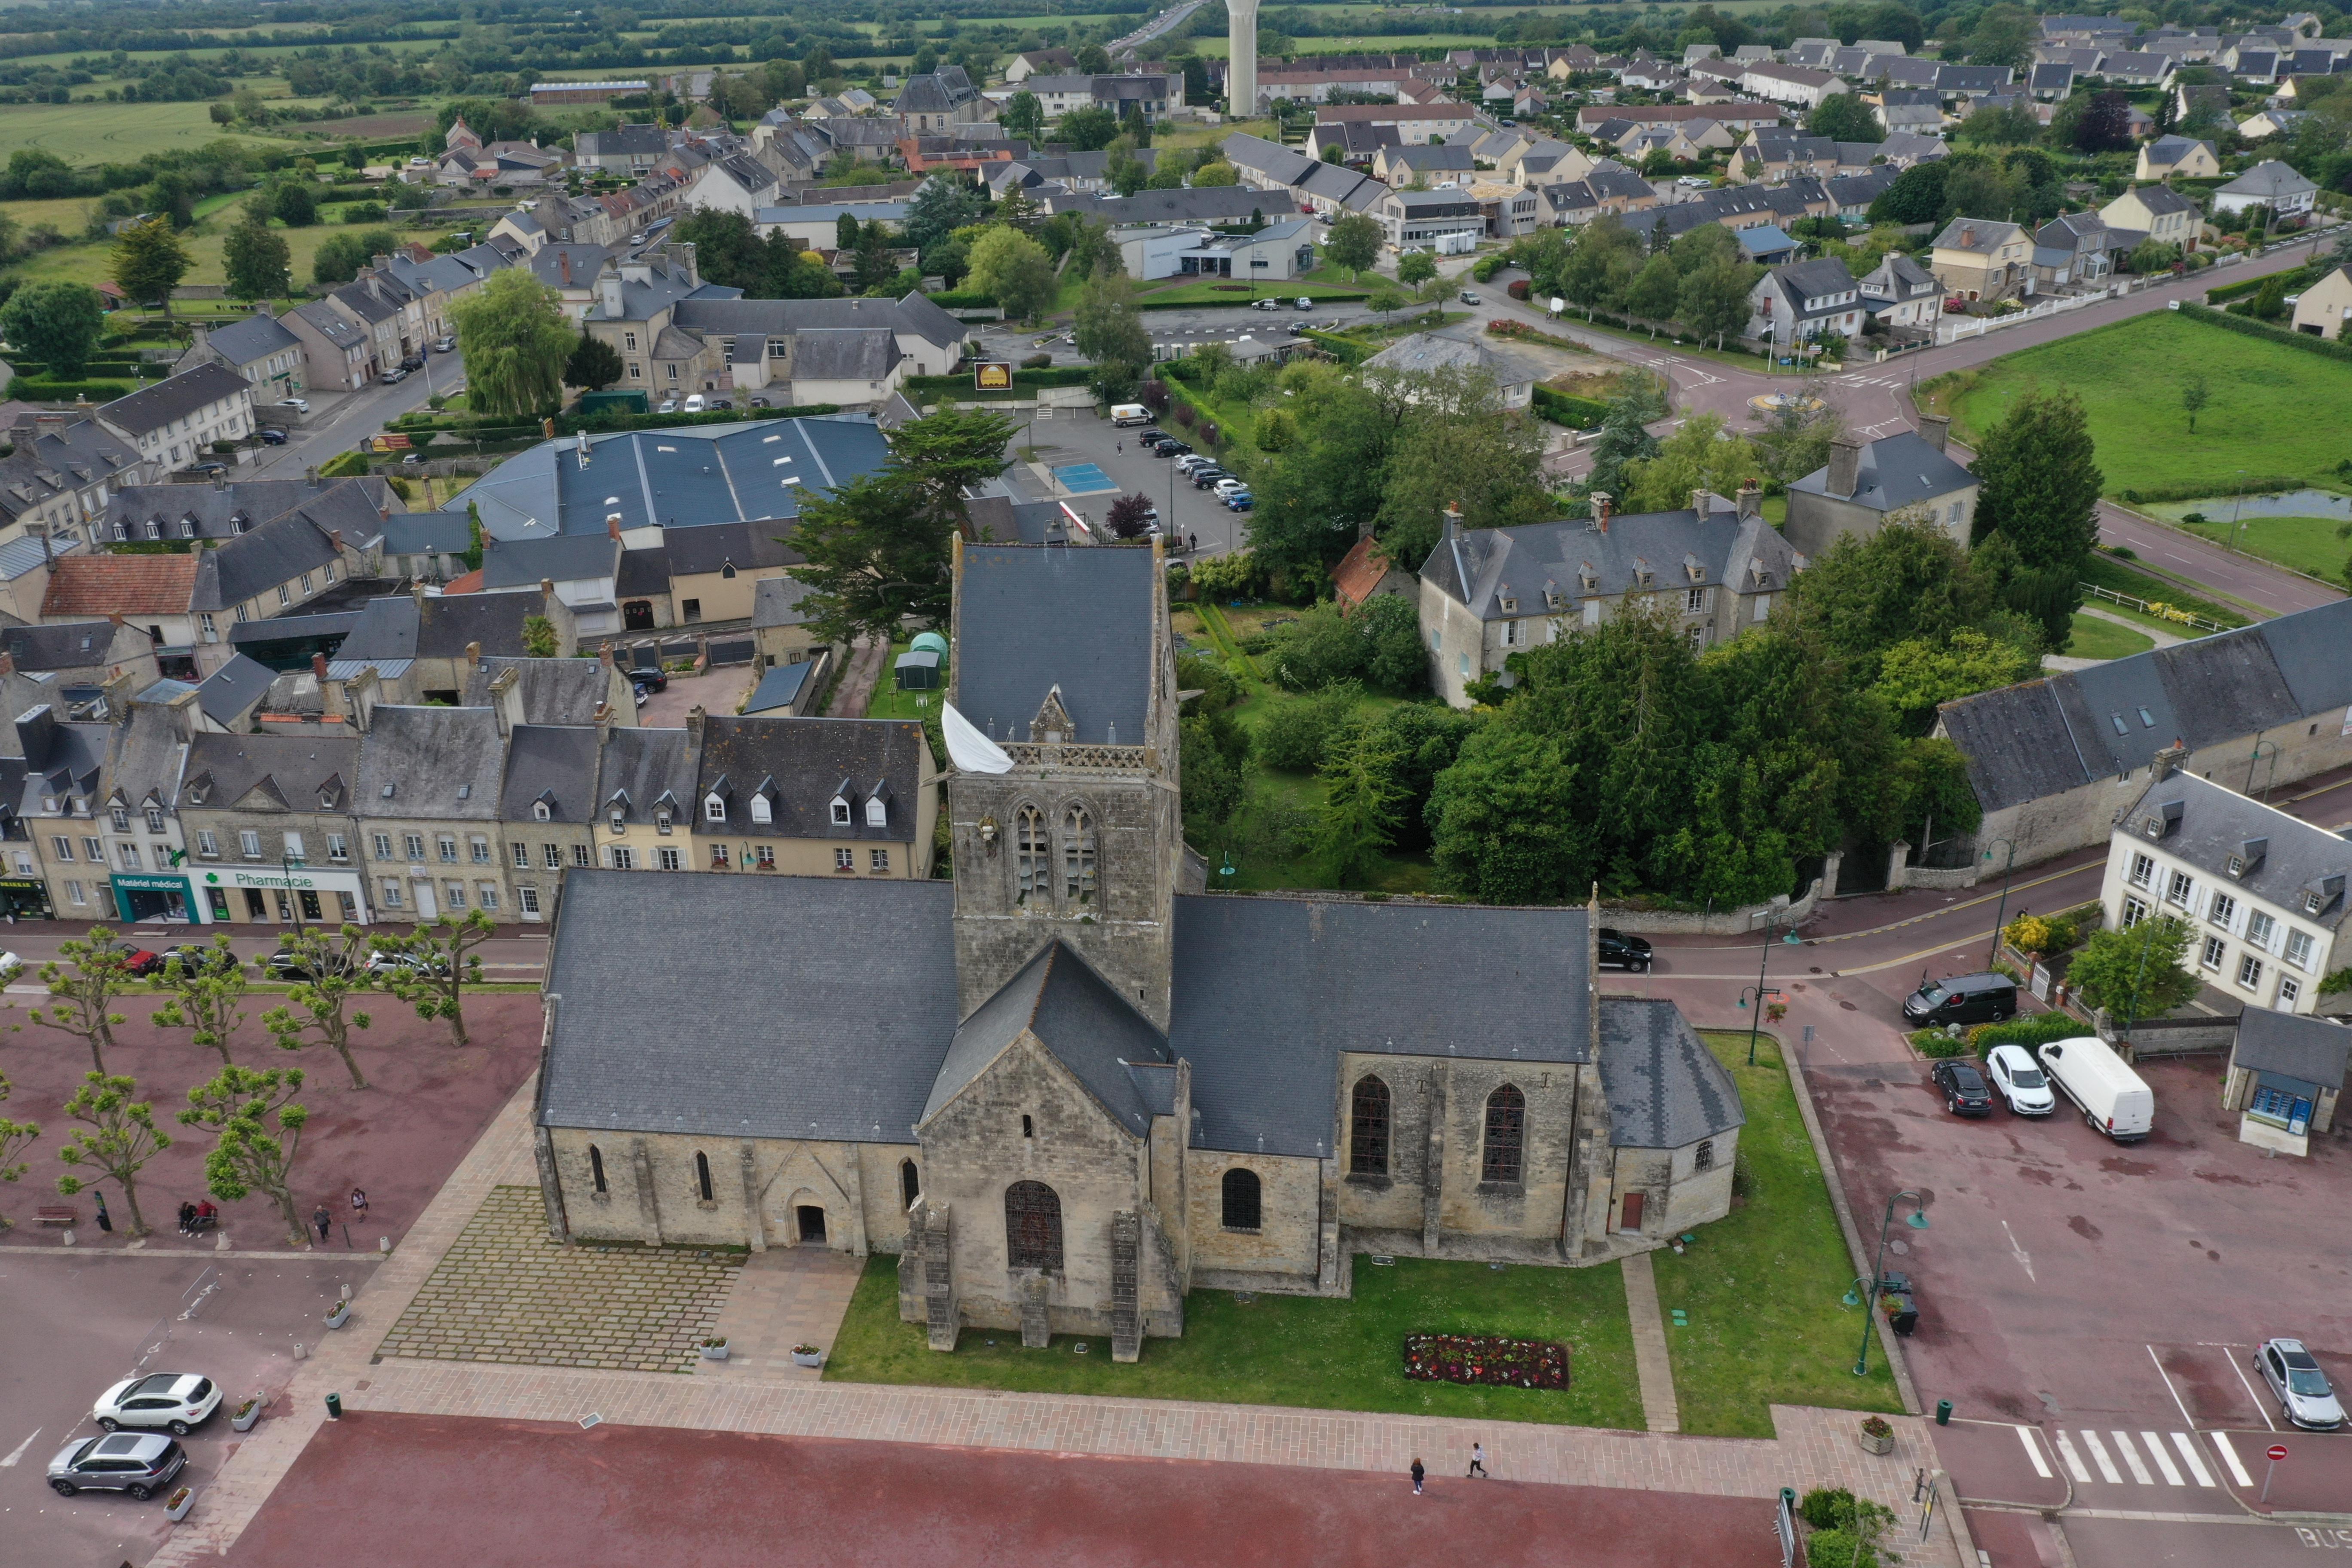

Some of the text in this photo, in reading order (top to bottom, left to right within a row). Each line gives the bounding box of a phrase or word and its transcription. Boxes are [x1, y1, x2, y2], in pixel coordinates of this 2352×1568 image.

[117, 879, 183, 888] Matériel médical
[236, 873, 313, 887] Pharmacie
[2294, 1527, 2352, 1549] BUS
